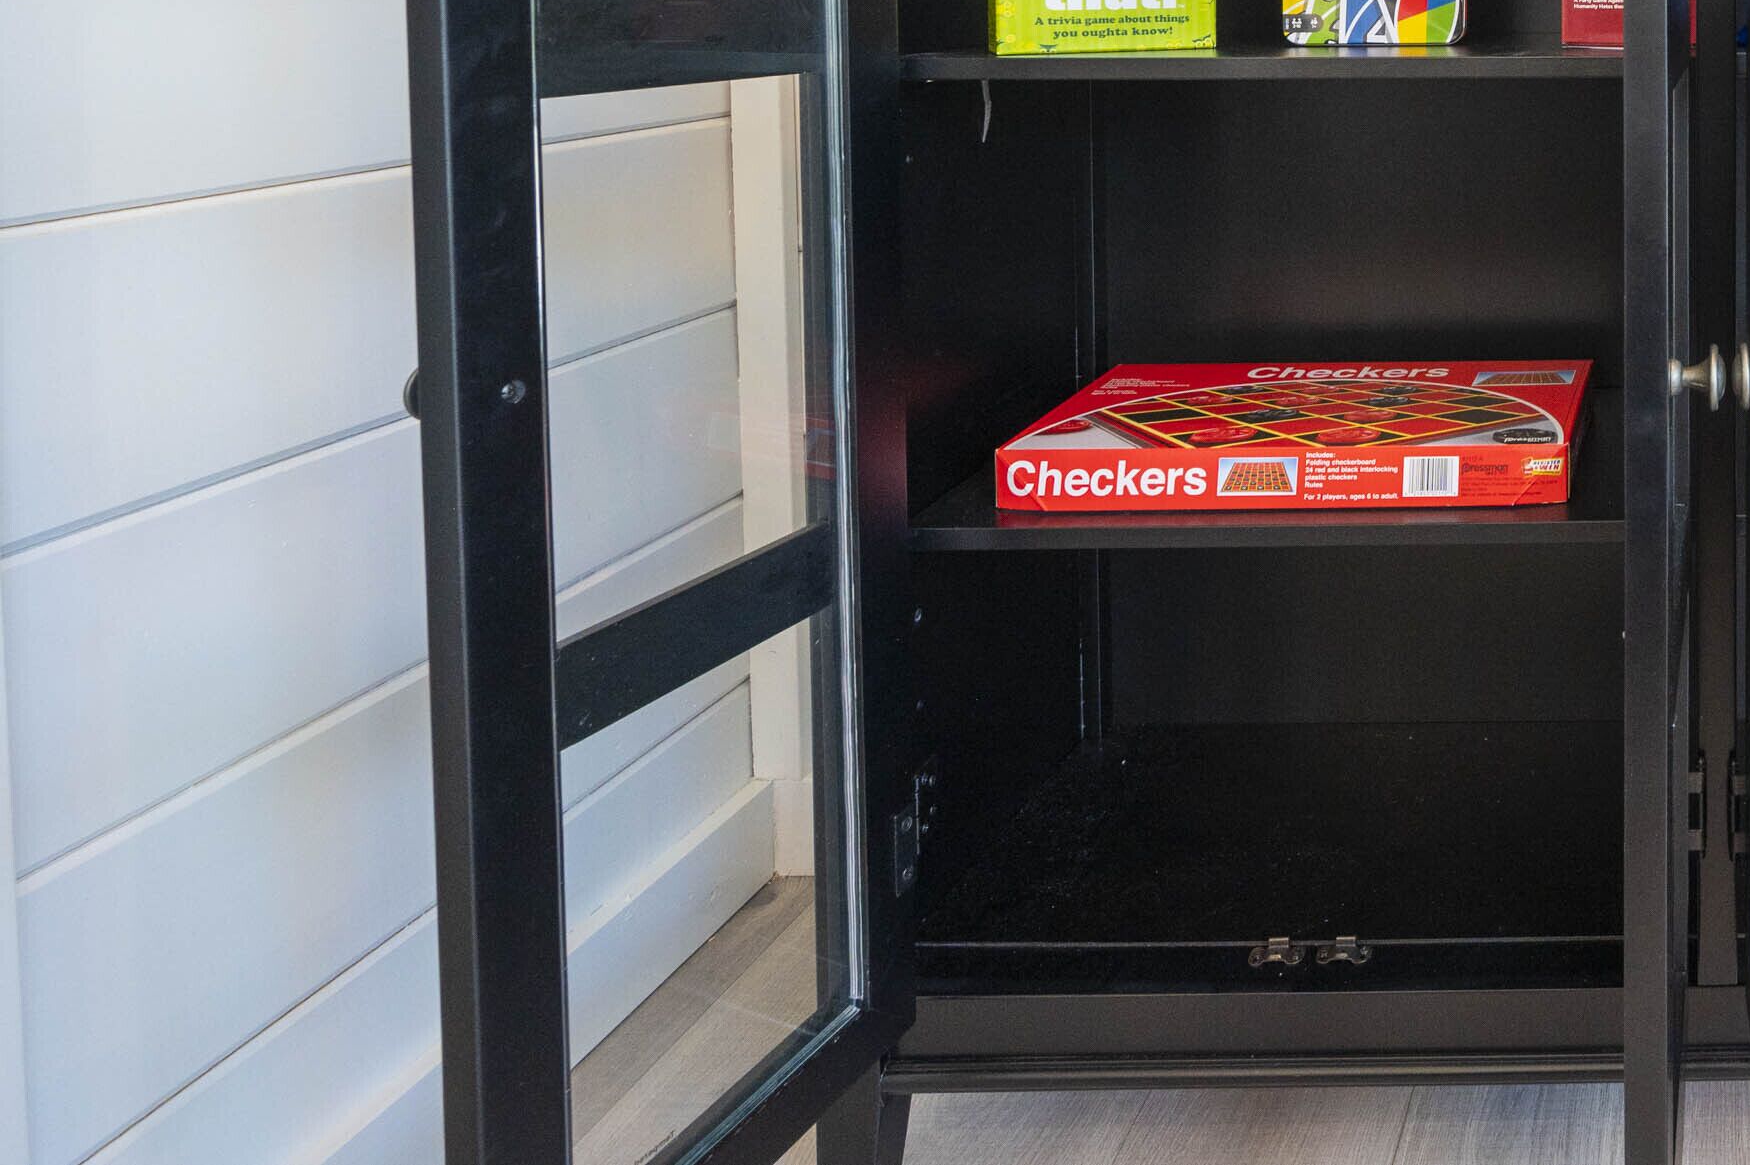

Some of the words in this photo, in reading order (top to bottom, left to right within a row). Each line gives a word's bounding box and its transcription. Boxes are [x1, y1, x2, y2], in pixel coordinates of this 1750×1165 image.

[1035, 17, 1044, 25] A
[1048, 17, 1082, 25] trivia
[1085, 17, 1115, 26] game
[1118, 15, 1151, 24] about
[1154, 14, 1190, 24] things
[1053, 30, 1078, 39] you
[1082, 27, 1128, 38] oughta
[1132, 26, 1173, 36] know!
[1247, 366, 1450, 379] Checkers
[1006, 459, 1208, 497] Checkers
[1322, 493, 1348, 501] players,
